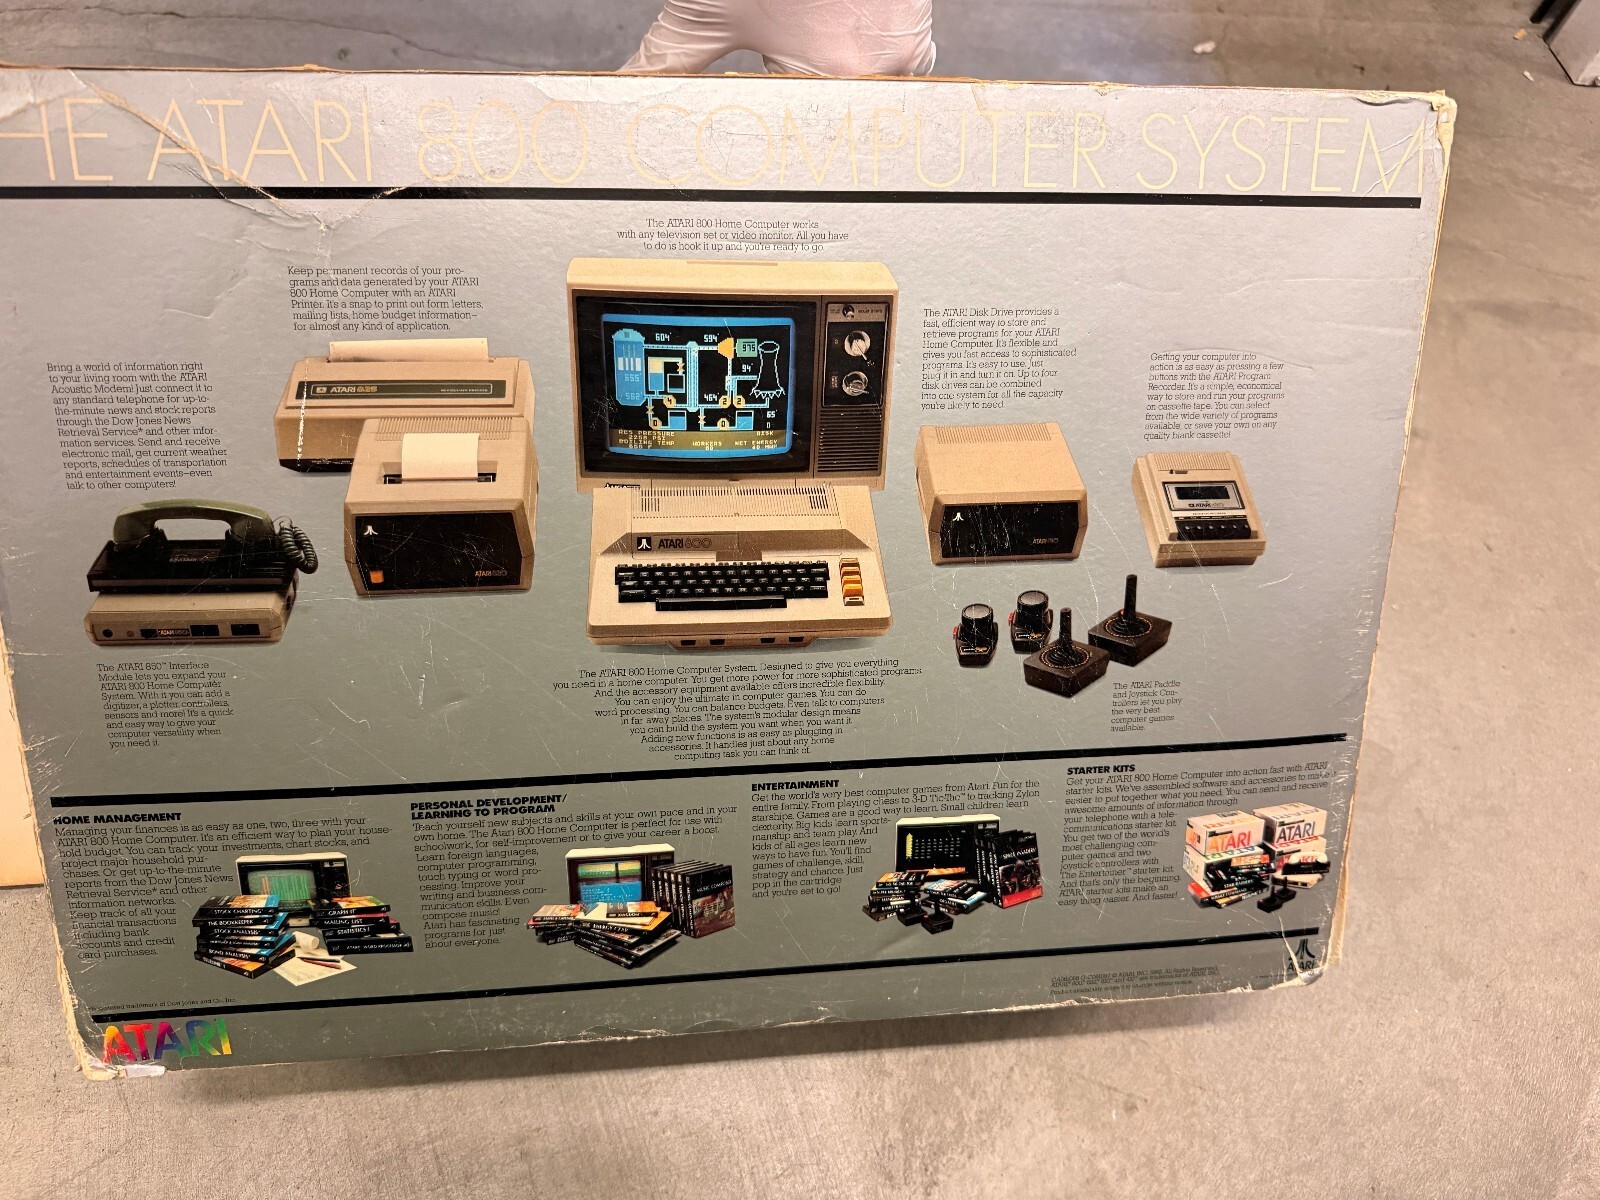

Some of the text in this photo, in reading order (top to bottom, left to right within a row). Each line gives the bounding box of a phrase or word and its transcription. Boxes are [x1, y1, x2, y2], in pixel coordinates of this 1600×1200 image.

[147, 98, 373, 182] ATARI
[418, 100, 588, 184] 800
[627, 103, 1107, 189] COMPUTER
[1135, 112, 1426, 194] SYSTEM
[646, 218, 818, 231] The ATARI 800 Home Computer works
[617, 230, 635, 239] with
[638, 232, 654, 241] any
[657, 230, 700, 239] television
[703, 230, 717, 239] set
[731, 230, 756, 240] video
[796, 231, 807, 240] All
[810, 233, 825, 242] you
[828, 231, 848, 240] have
[644, 241, 652, 250] to
[654, 241, 666, 250] do
[668, 241, 676, 250] is
[678, 241, 701, 250] hook
[703, 241, 708, 250] it
[711, 243, 723, 252] up
[725, 241, 742, 250] and
[771, 242, 800, 253] ready
[800, 242, 811, 251] to
[288, 266, 463, 278] Keep permanent records of your pro-
[289, 277, 478, 289] grams and data generated by your ATARI
[290, 288, 307, 297] 800
[309, 288, 338, 297] Home
[341, 288, 389, 300] Computer
[391, 288, 411, 297] with
[428, 288, 455, 297] ATARI
[924, 308, 1058, 318] The ATARI Disk Drive provides a
[1150, 352, 1256, 363] Getting your computer into
[47, 362, 203, 374] Bring a world of information right
[49, 375, 58, 383] to
[60, 376, 80, 385] your
[84, 374, 109, 385] living
[139, 374, 159, 382] with
[161, 374, 176, 382] the
[179, 373, 207, 381] ATARI
[658, 538, 684, 549] ATARI
[1066, 762, 1327, 787] Get your ATARI 800 Home Computer into action fast with ATARI
[1067, 763, 1135, 775] STARTER KITS
[751, 779, 839, 791] ENTERTAINMENT
[752, 793, 768, 802] Get
[771, 792, 785, 801] the
[788, 790, 819, 800] world's
[822, 790, 841, 801] very
[844, 788, 863, 797] best
[866, 786, 909, 798] computer
[912, 785, 942, 796] games
[945, 783, 965, 792] from
[992, 781, 1008, 790] Fun
[1010, 781, 1022, 789] for
[1025, 780, 1039, 788] the
[410, 794, 566, 811] PERSONAL DEVELOPMENT/
[411, 804, 555, 820] LEARNING TO PROGRAM
[53, 812, 181, 825] HOME MANAGEMENT
[54, 826, 107, 838] Managing
[110, 826, 132, 836] your
[134, 824, 178, 833] finances
[180, 823, 189, 832] is
[205, 823, 229, 833] easy
[232, 822, 244, 830] as
[246, 821, 267, 832] one,
[270, 820, 289, 831] two,
[291, 819, 318, 828] three
[320, 818, 342, 827] with
[344, 818, 365, 828] your
[1276, 821, 1316, 843] ATARI
[1207, 831, 1252, 852] ATARI
[102, 1017, 233, 1063] ATARI
